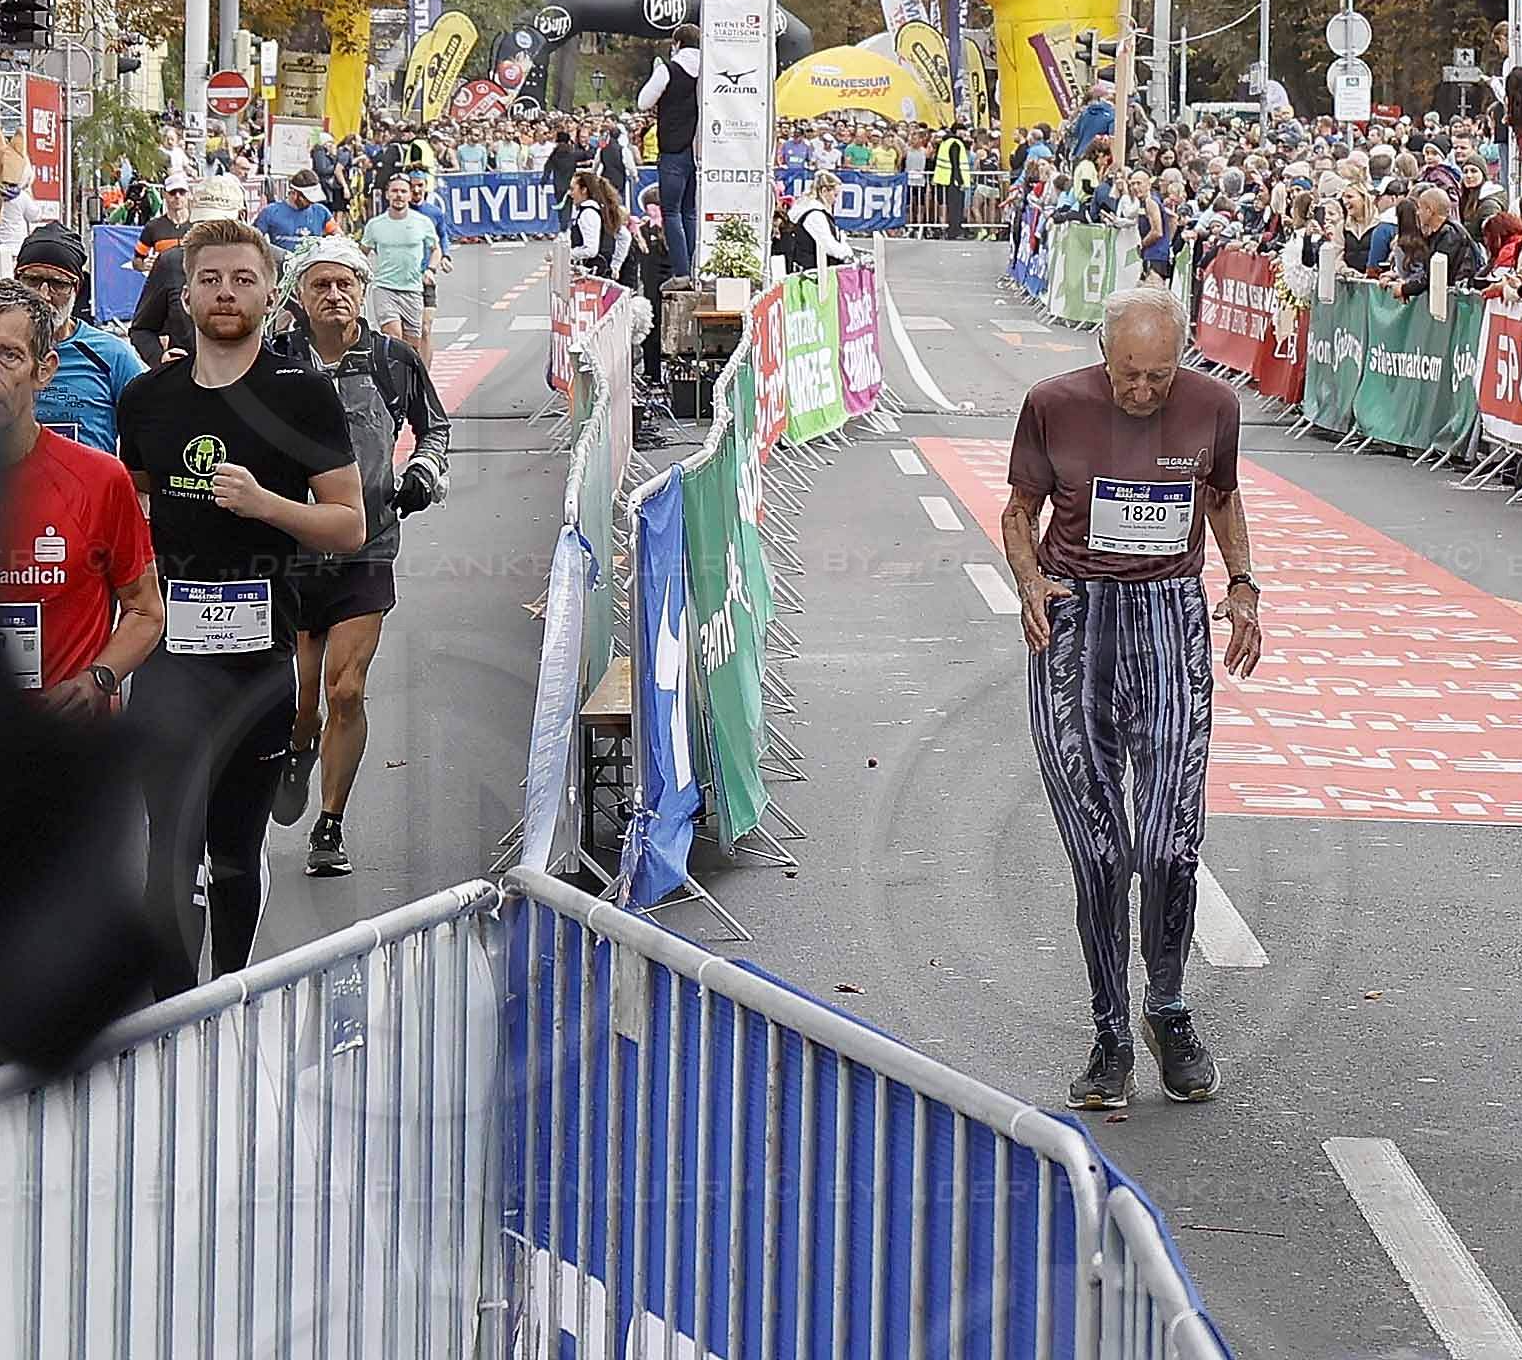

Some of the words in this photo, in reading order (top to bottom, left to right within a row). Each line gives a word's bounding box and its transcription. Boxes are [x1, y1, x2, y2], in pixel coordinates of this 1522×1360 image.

[714, 21, 746, 29] WIENER
[811, 76, 890, 88] MAGNESIUM
[838, 87, 891, 98] SPORT
[707, 170, 763, 183] GRAZ
[1121, 505, 1168, 522] 1820
[200, 605, 236, 622] 427
